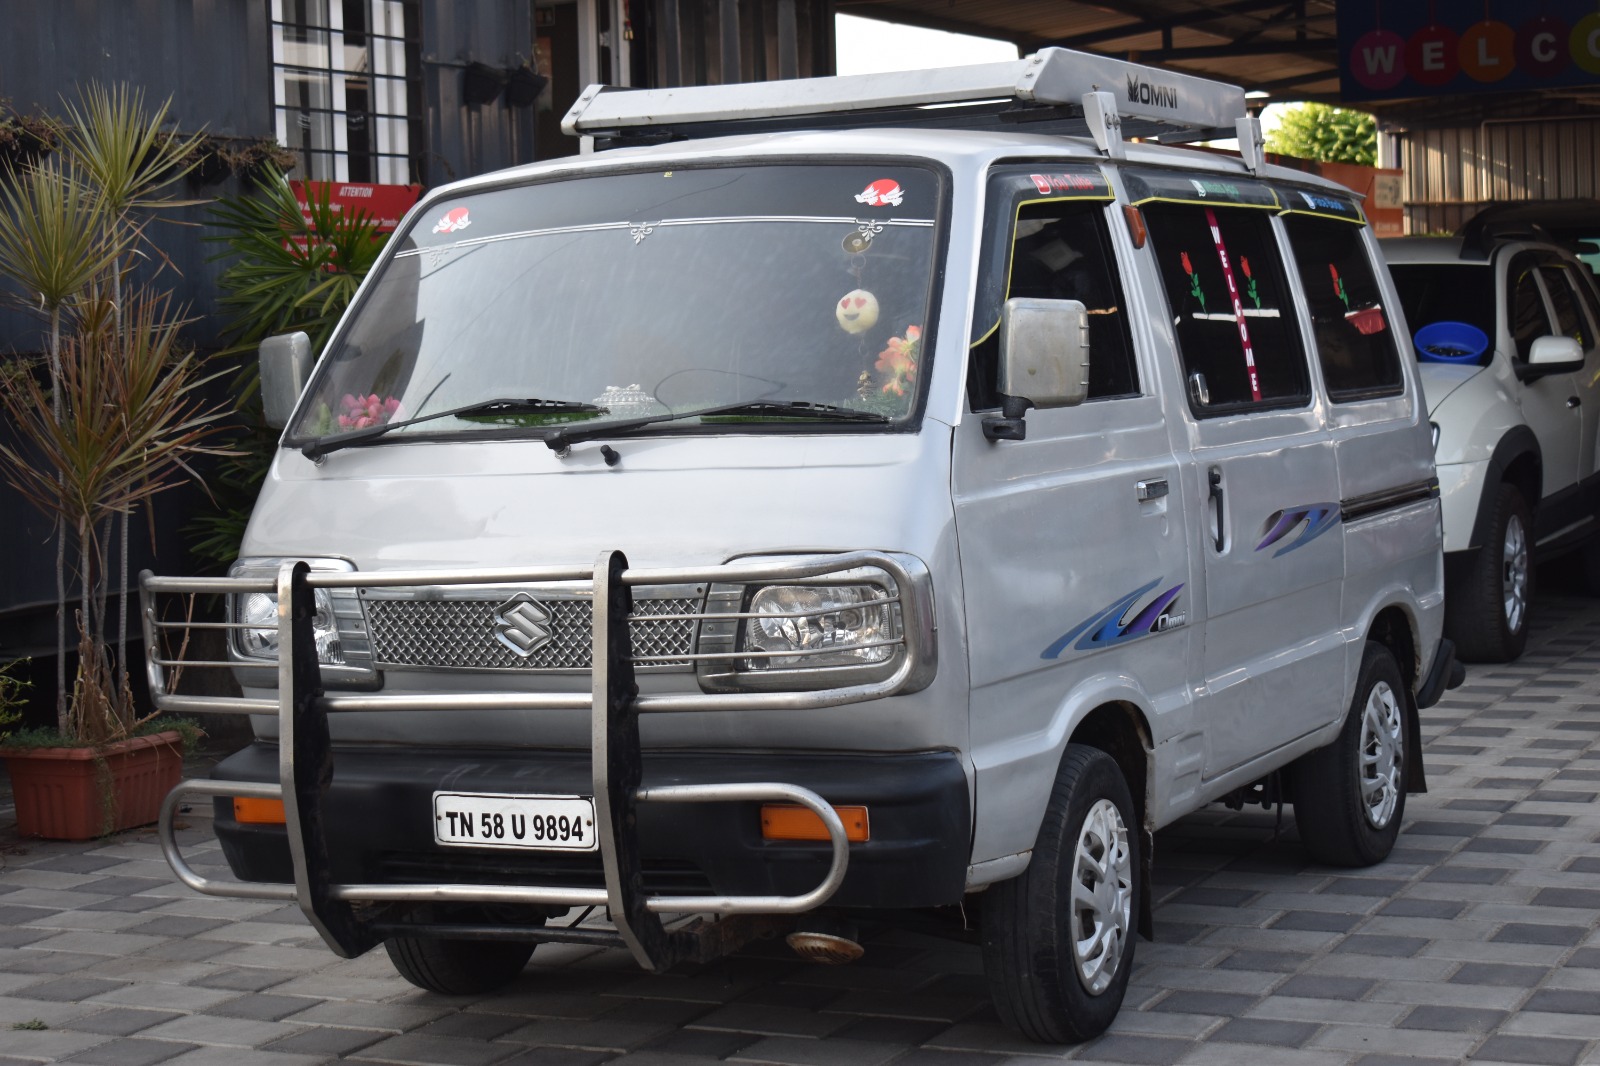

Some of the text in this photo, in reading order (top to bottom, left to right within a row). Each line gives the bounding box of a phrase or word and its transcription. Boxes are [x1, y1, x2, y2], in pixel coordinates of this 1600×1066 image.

[1140, 82, 1178, 109] OMNI
[339, 186, 374, 198] ATTENTION
[1210, 226, 1258, 392] WELCOME
[1157, 610, 1185, 632] Omni
[445, 811, 584, 842] TN 58 U 9894
